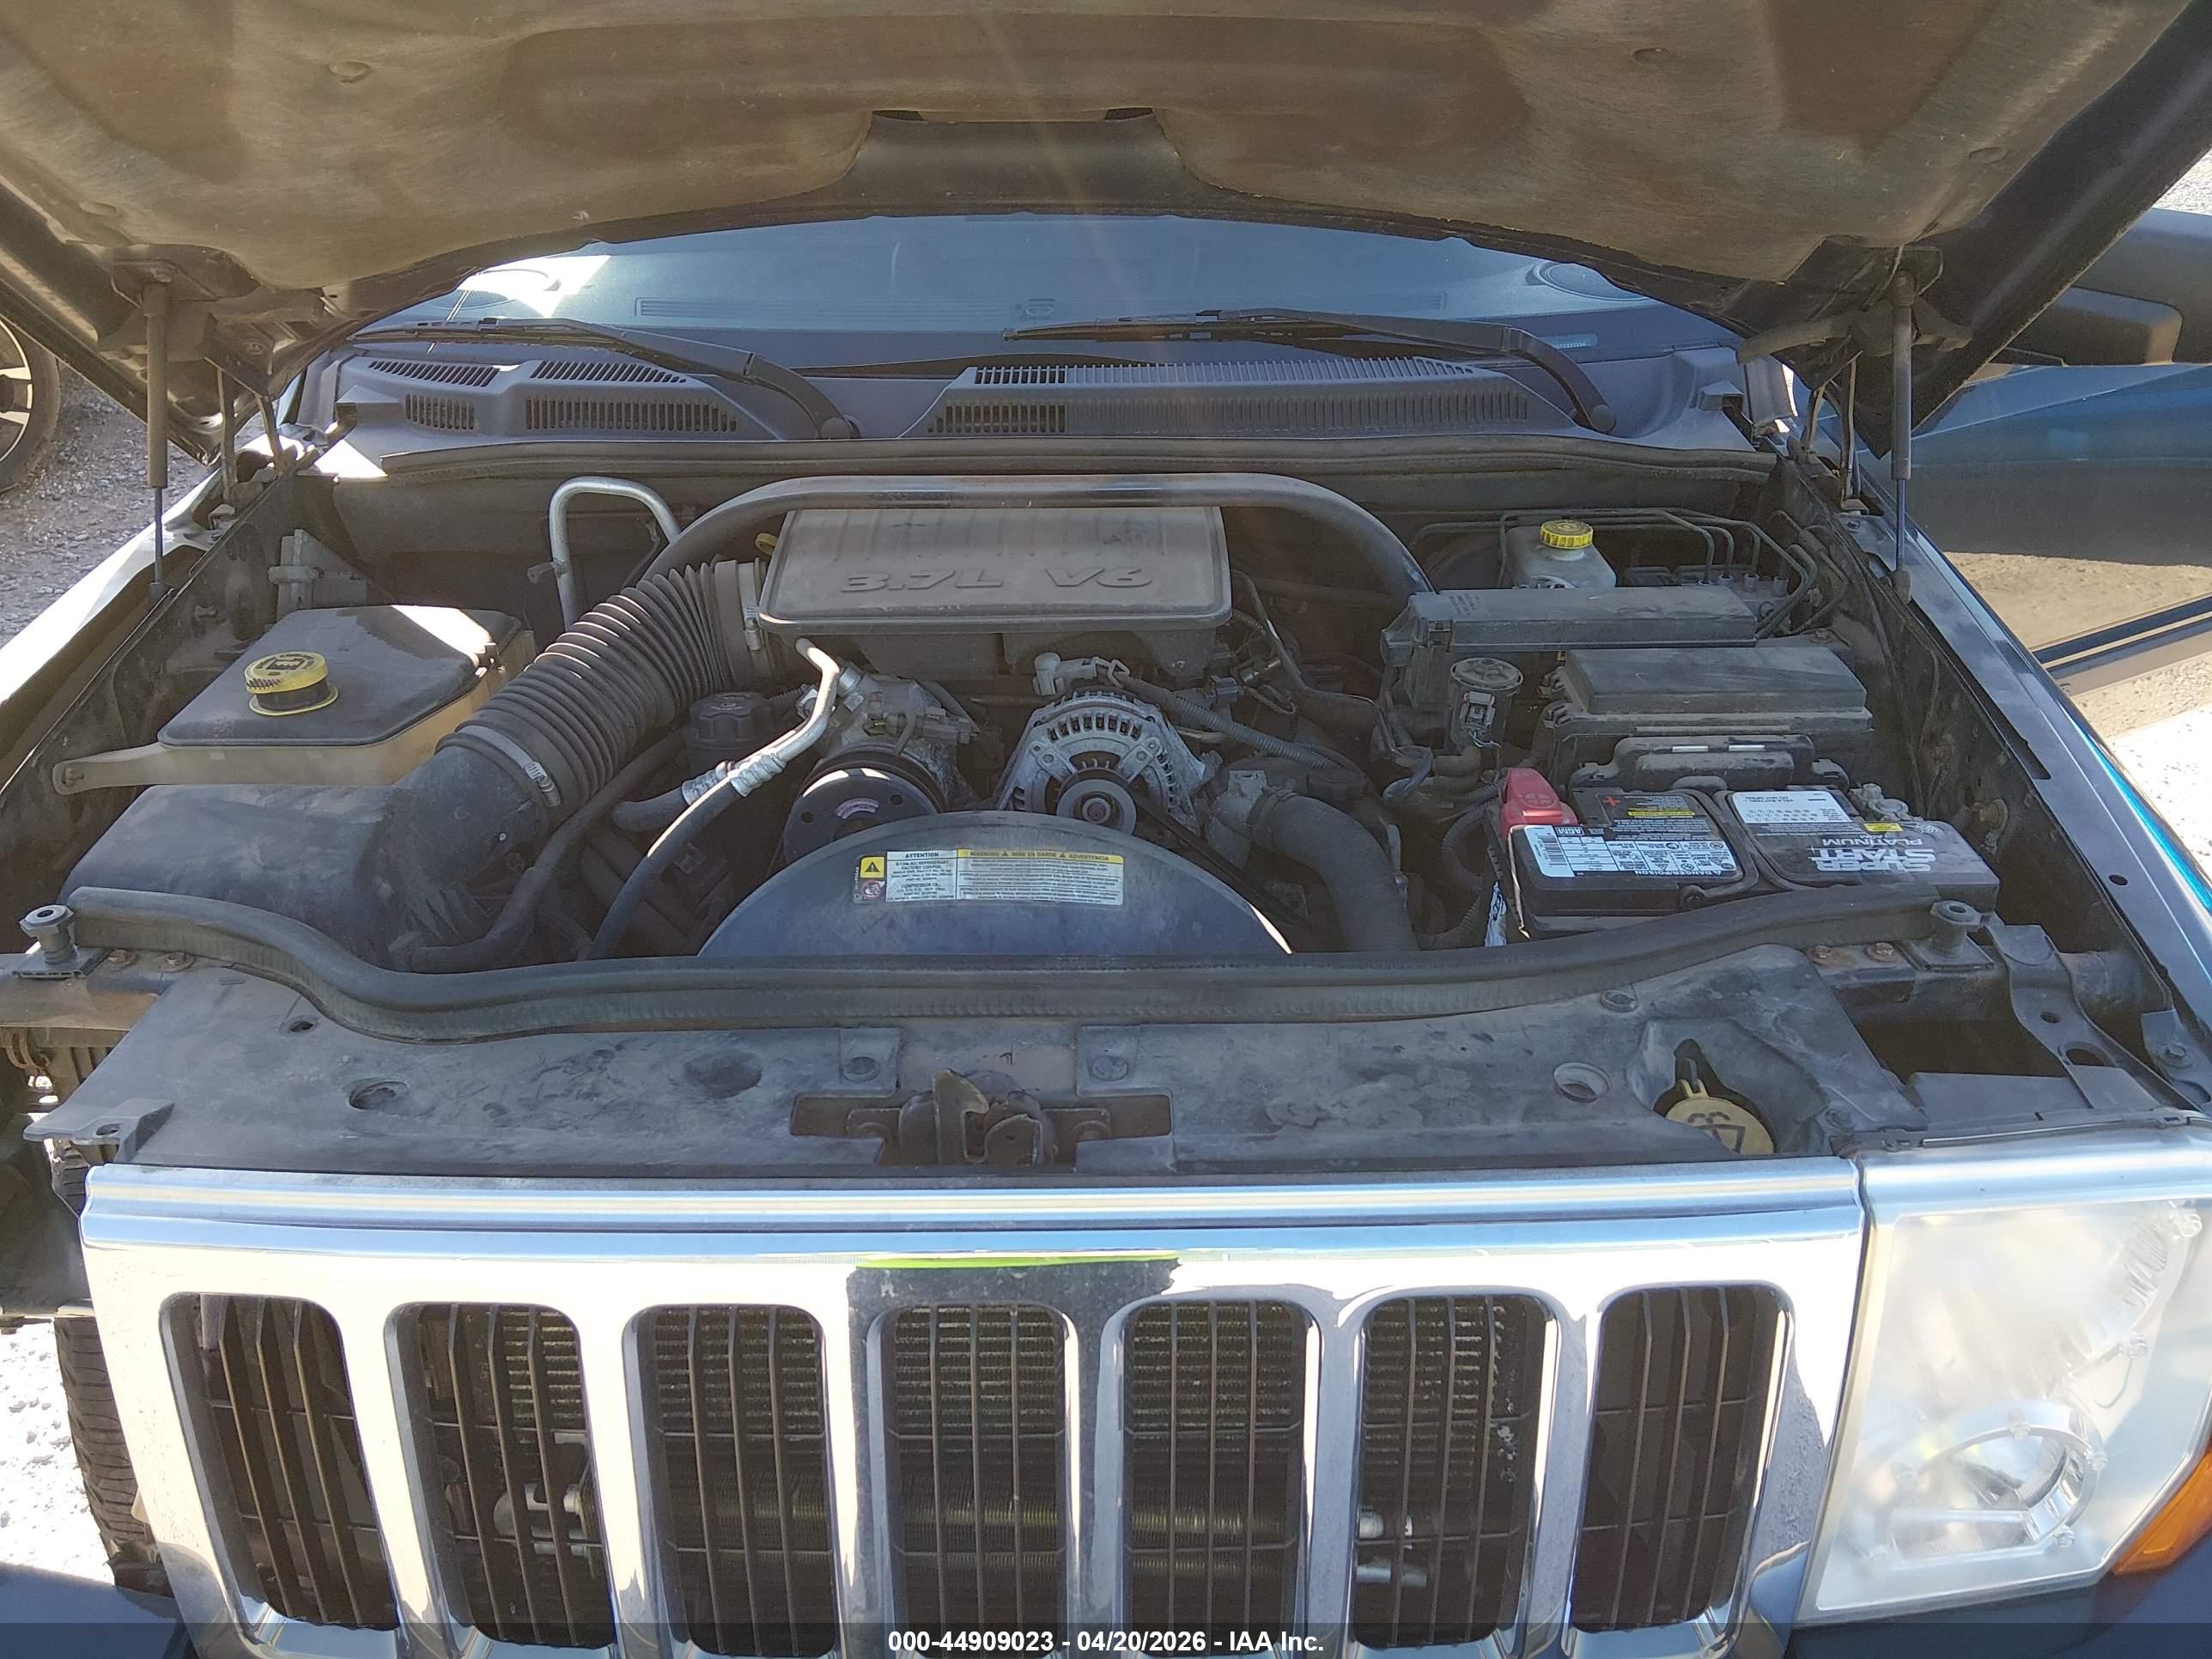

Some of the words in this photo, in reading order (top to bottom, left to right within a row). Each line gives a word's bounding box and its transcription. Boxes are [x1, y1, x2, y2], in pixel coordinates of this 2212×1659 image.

[841, 568, 1003, 593] 3.7L
[1045, 567, 1154, 589] V6
[1821, 838, 1923, 847] PLATINUM
[1808, 848, 1936, 861] START
[1815, 860, 1931, 872] SUPER
